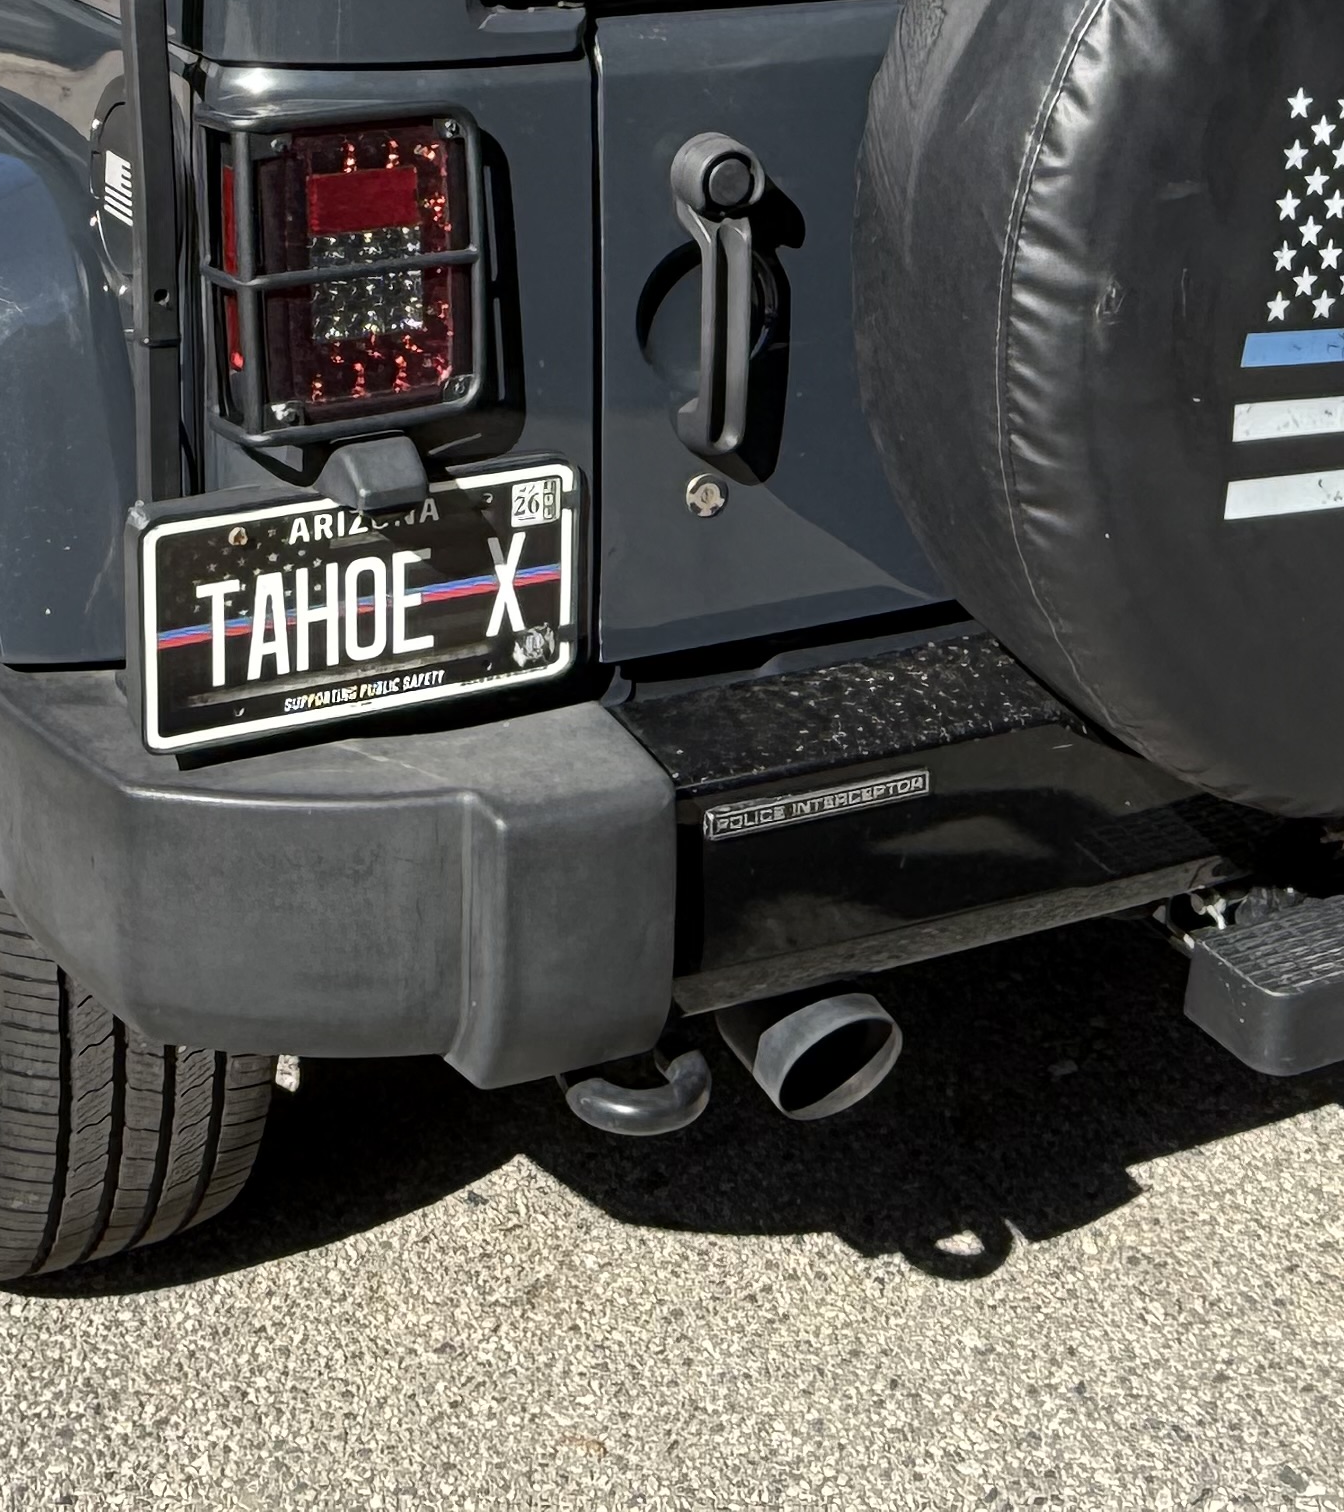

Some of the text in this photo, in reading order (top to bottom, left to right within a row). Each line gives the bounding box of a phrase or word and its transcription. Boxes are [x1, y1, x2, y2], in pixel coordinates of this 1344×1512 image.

[514, 491, 540, 517] 26
[196, 531, 528, 688] TAHOE X
[284, 684, 358, 712] SUPPORTING
[359, 676, 401, 699] PUBLIC
[402, 669, 446, 691] SAFETY
[716, 775, 924, 834] POLICE INTERCEPTOR
